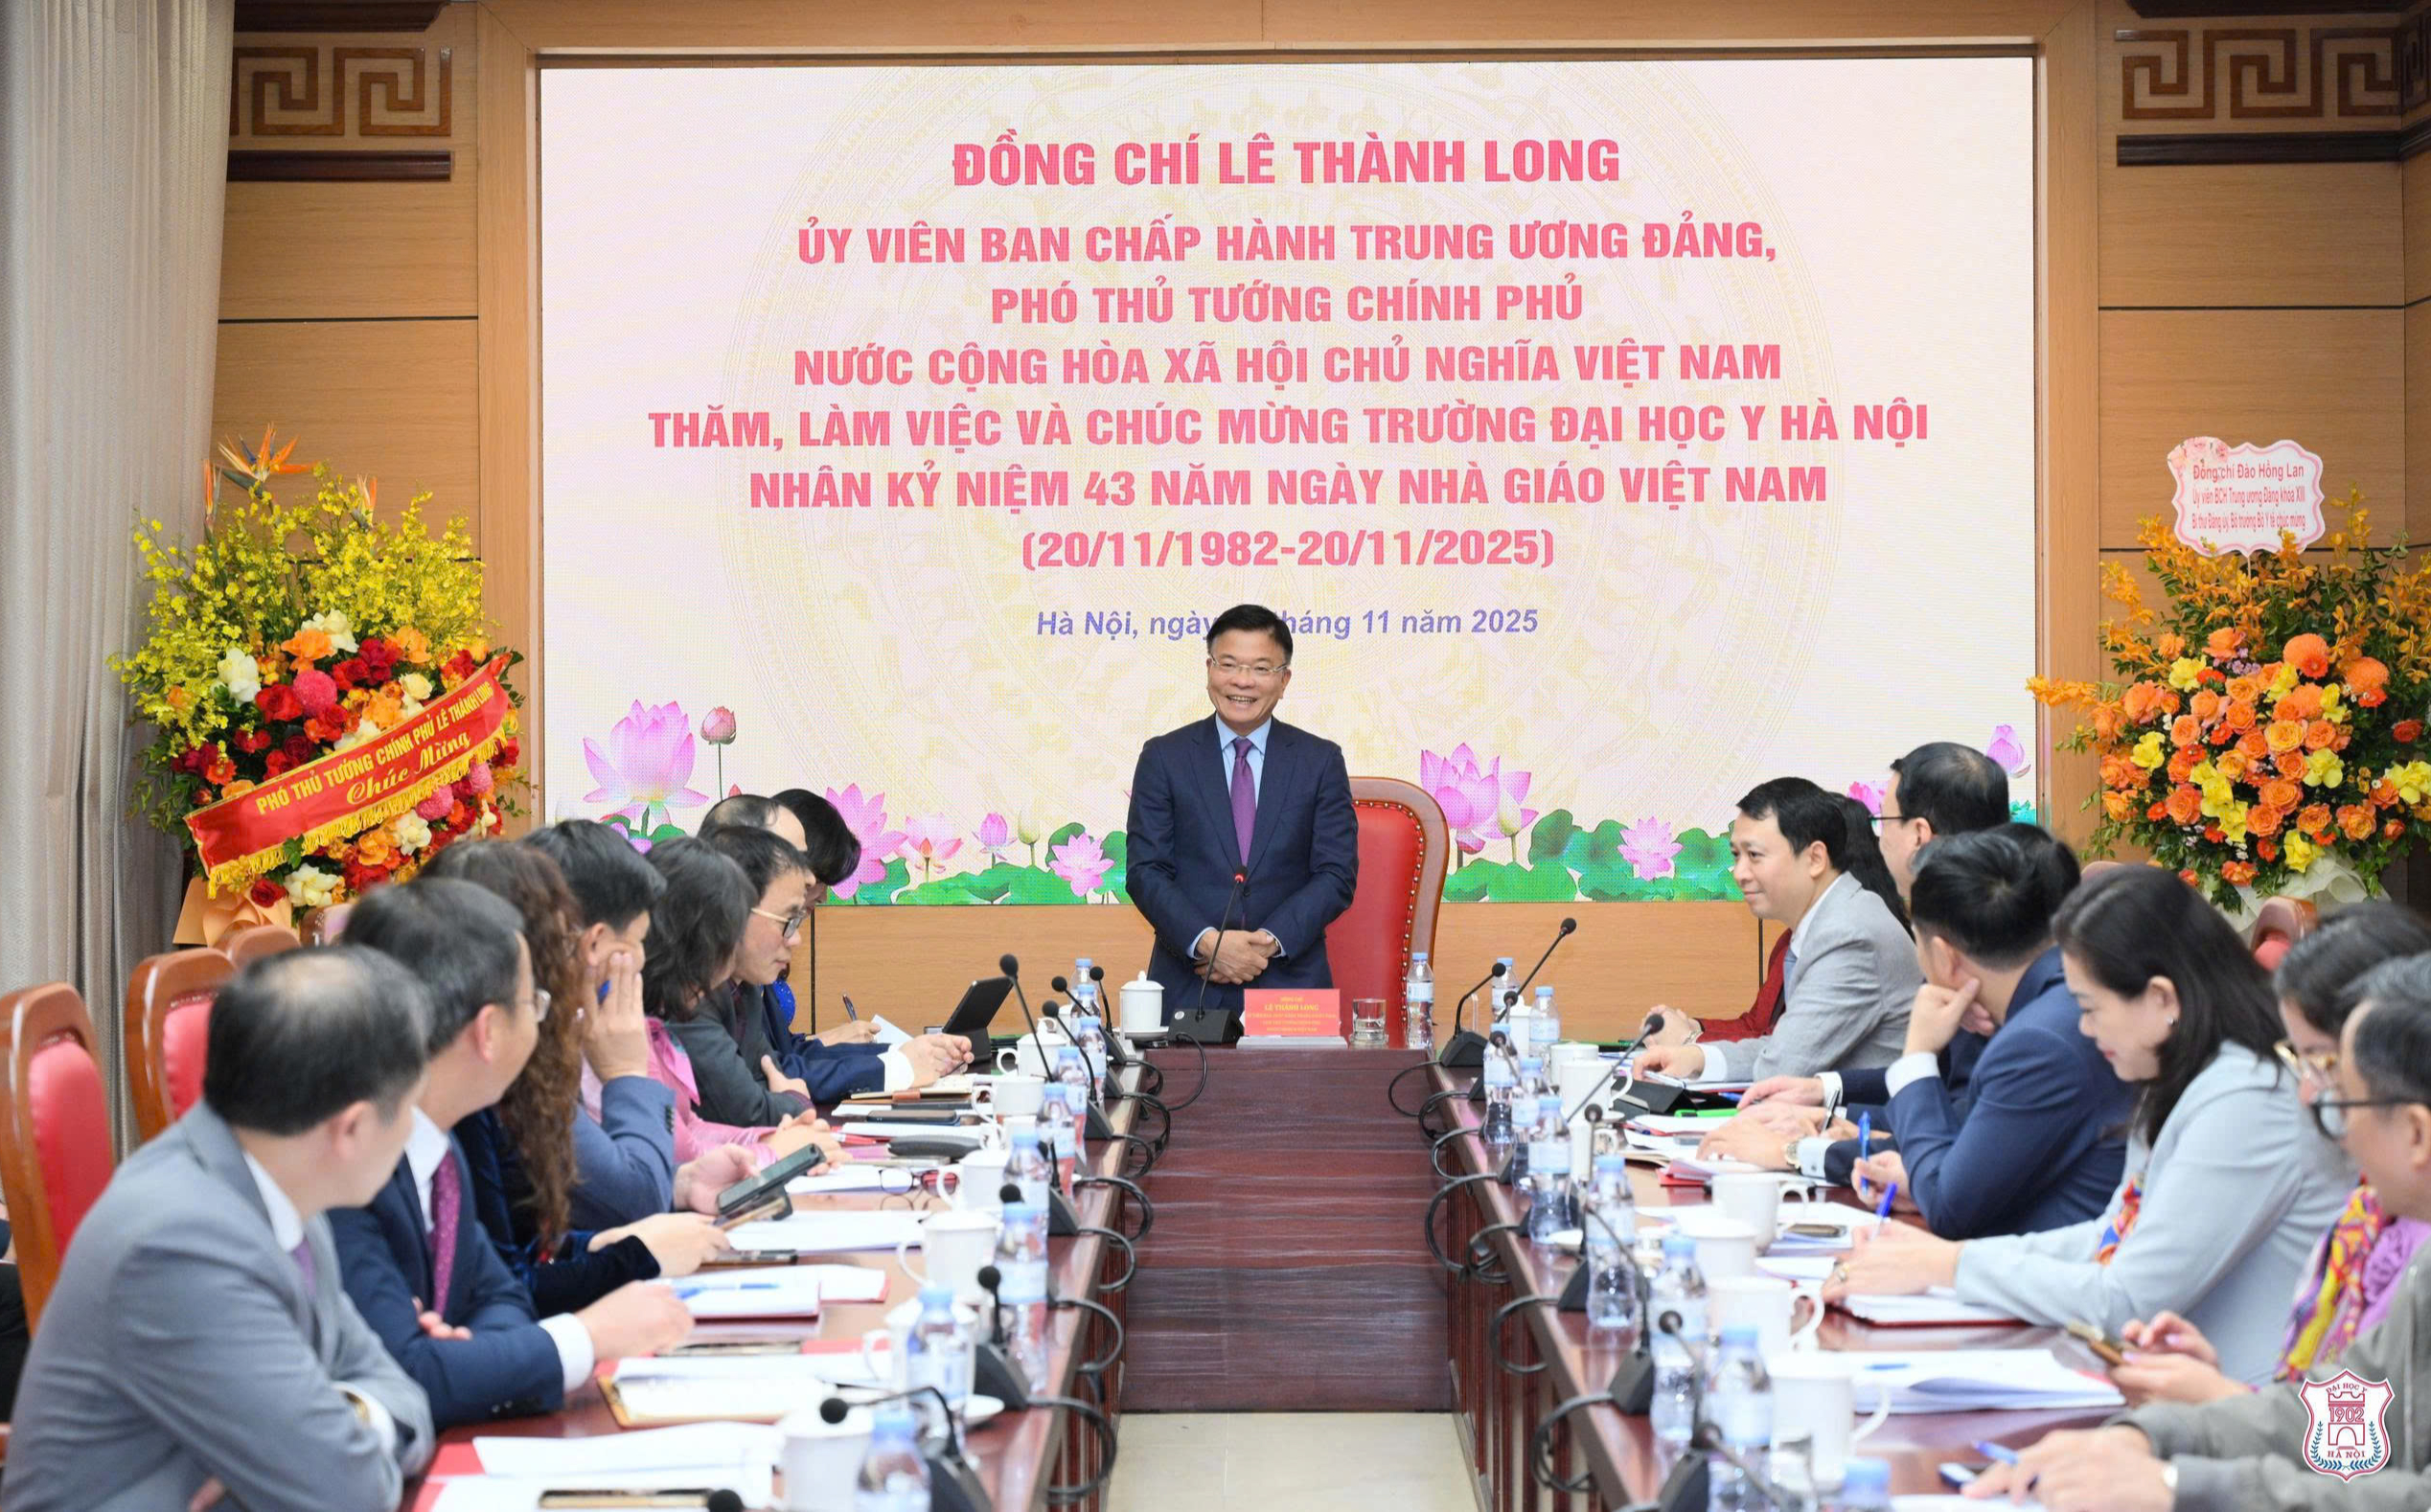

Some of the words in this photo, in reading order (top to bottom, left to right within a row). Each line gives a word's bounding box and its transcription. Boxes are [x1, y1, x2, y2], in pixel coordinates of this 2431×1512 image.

[952, 128, 1095, 186] ĐỒNG
[1114, 133, 1200, 186] CHÍ
[1219, 132, 1275, 184] LÊ
[1294, 131, 1465, 184] THÀNH
[1484, 139, 1619, 182] LONG
[799, 216, 853, 264] ỦY
[867, 219, 965, 263] VIÊN
[981, 226, 1069, 263] BAN
[1086, 215, 1201, 263] CHẤP
[1217, 218, 1335, 261] HÀNH
[1350, 223, 1493, 261] TRUNG
[1509, 219, 1627, 260] ƯƠNG
[1642, 210, 1776, 262] ĐẢNG,
[992, 281, 1078, 324] PHÓ
[1092, 275, 1173, 323] THỦ
[1187, 279, 1331, 322] TƯỚNG
[1347, 278, 1480, 322] CHÍNH
[1497, 272, 1582, 321] PHỦ
[794, 342, 913, 386] NƯỚC
[929, 342, 1046, 393] CỘNG
[1063, 339, 1150, 383] HÒA
[1164, 341, 1221, 383] XÃ
[1237, 340, 1307, 391] HỘI
[1324, 334, 1410, 382] CHỦ
[1426, 339, 1560, 382] NGHĨA
[1573, 337, 1665, 388] VIỆT
[1681, 344, 1780, 380] NAM
[648, 404, 783, 451] THĂM,
[800, 403, 890, 447] LÀM
[906, 403, 1001, 454] VIỆC
[1017, 402, 1071, 445] VÀ
[1087, 401, 1202, 445] CHÚC
[1219, 401, 1348, 445] MỪNG
[1363, 399, 1535, 444] TRƯỜNG
[1550, 406, 1622, 449] ĐẠI
[1639, 405, 1725, 449] HỌC
[1742, 405, 1765, 441] Y
[1781, 398, 1839, 441] HÀ
[1854, 397, 1927, 447] NỘI
[750, 466, 871, 509] NHÂN
[887, 459, 941, 508] KỶ
[956, 464, 1068, 514] NIỆM
[1084, 470, 1135, 506] 43
[1152, 463, 1250, 506] NĂM
[1268, 462, 1383, 505] NGÀY
[1399, 461, 1488, 504] NHÀ
[1504, 460, 1604, 504] GIÁO
[1619, 460, 1710, 511] VIỆT
[1726, 467, 1826, 502] NAM
[2286, 463, 2305, 478] Lan
[1022, 529, 1553, 571] (20/11/1982-20/11/2025)
[1037, 610, 1073, 635] Hà
[1084, 610, 1138, 640] Nội,
[1275, 610, 1351, 641] háng
[1362, 609, 1389, 634] 11
[1401, 609, 1462, 633] năm
[1471, 608, 1539, 633] 2025
[255, 786, 290, 815] PHÓ
[290, 769, 323, 800] THỦ
[323, 753, 374, 789] TƯỚNG
[376, 732, 414, 765] CHÍNH
[412, 714, 435, 745] PHỦ
[346, 767, 409, 805] Chúc
[415, 732, 470, 774] Mừng
